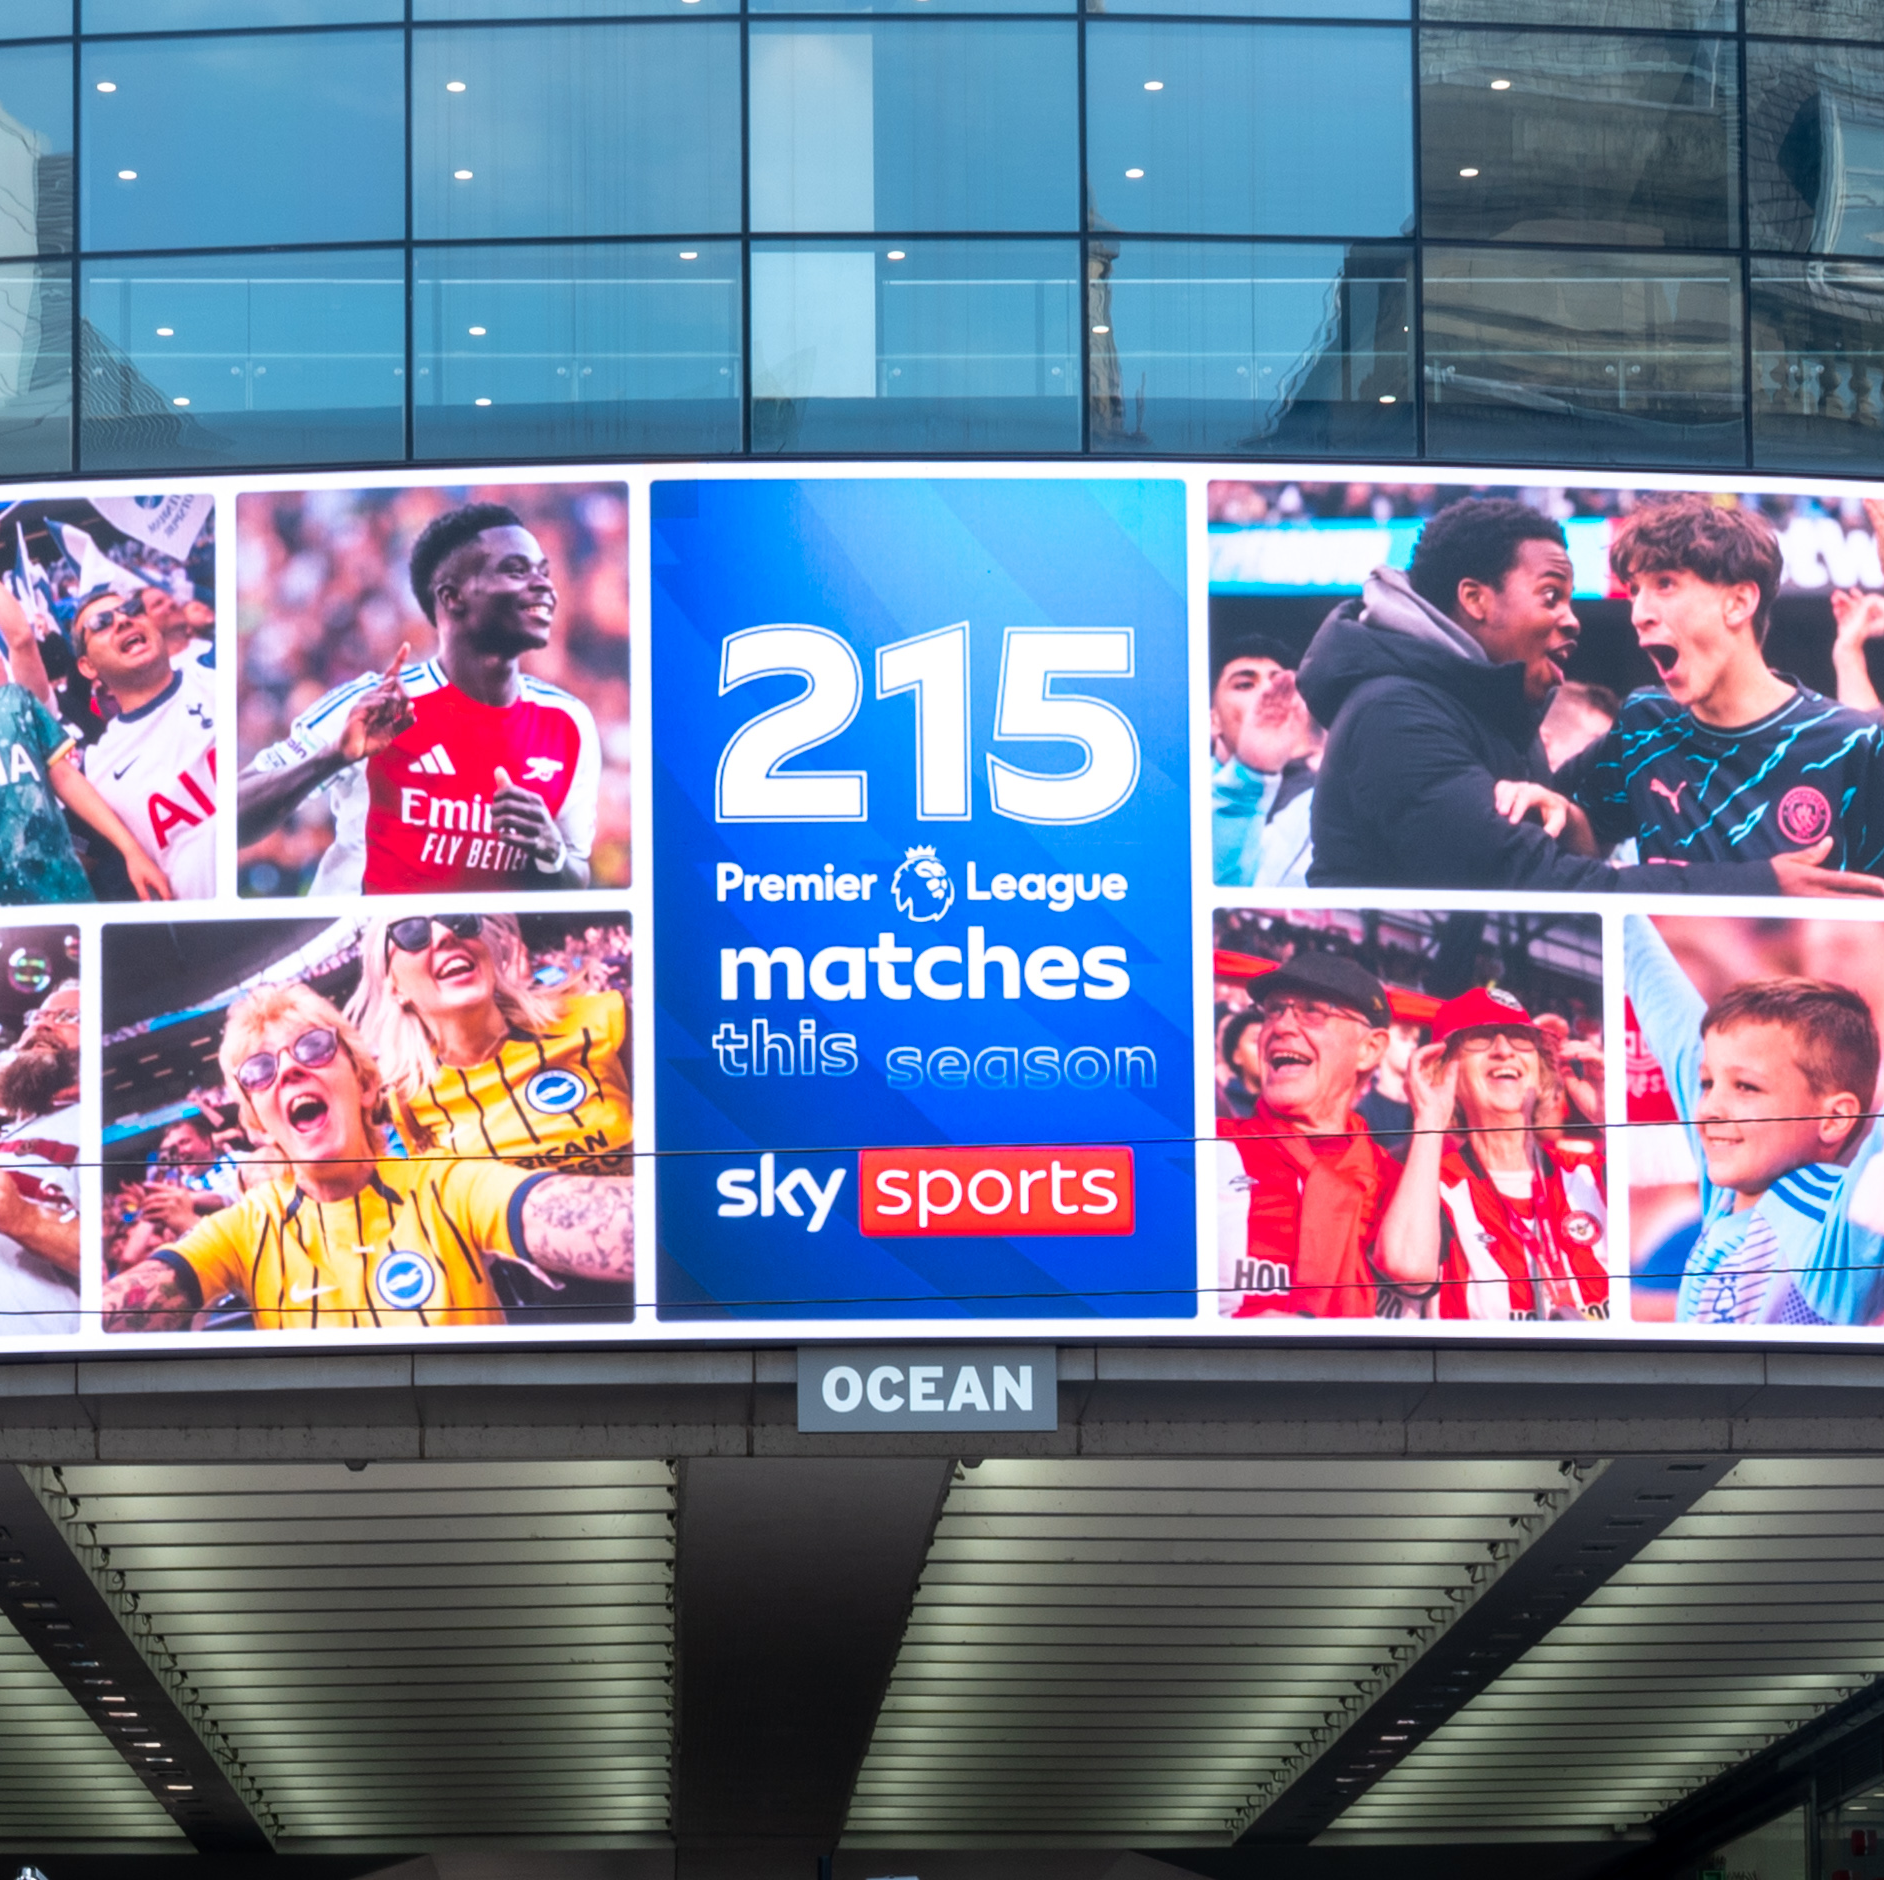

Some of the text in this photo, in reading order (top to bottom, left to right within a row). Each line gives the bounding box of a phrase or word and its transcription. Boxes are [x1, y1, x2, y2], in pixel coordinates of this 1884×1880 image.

[715, 620, 1141, 826] 215
[420, 834, 463, 866] FLY
[716, 862, 1128, 912] Premier League
[720, 926, 1131, 1001] matches
[712, 1018, 1158, 1090] this season
[717, 1152, 1118, 1233] sky sports
[821, 1365, 1034, 1413] OCEAN
